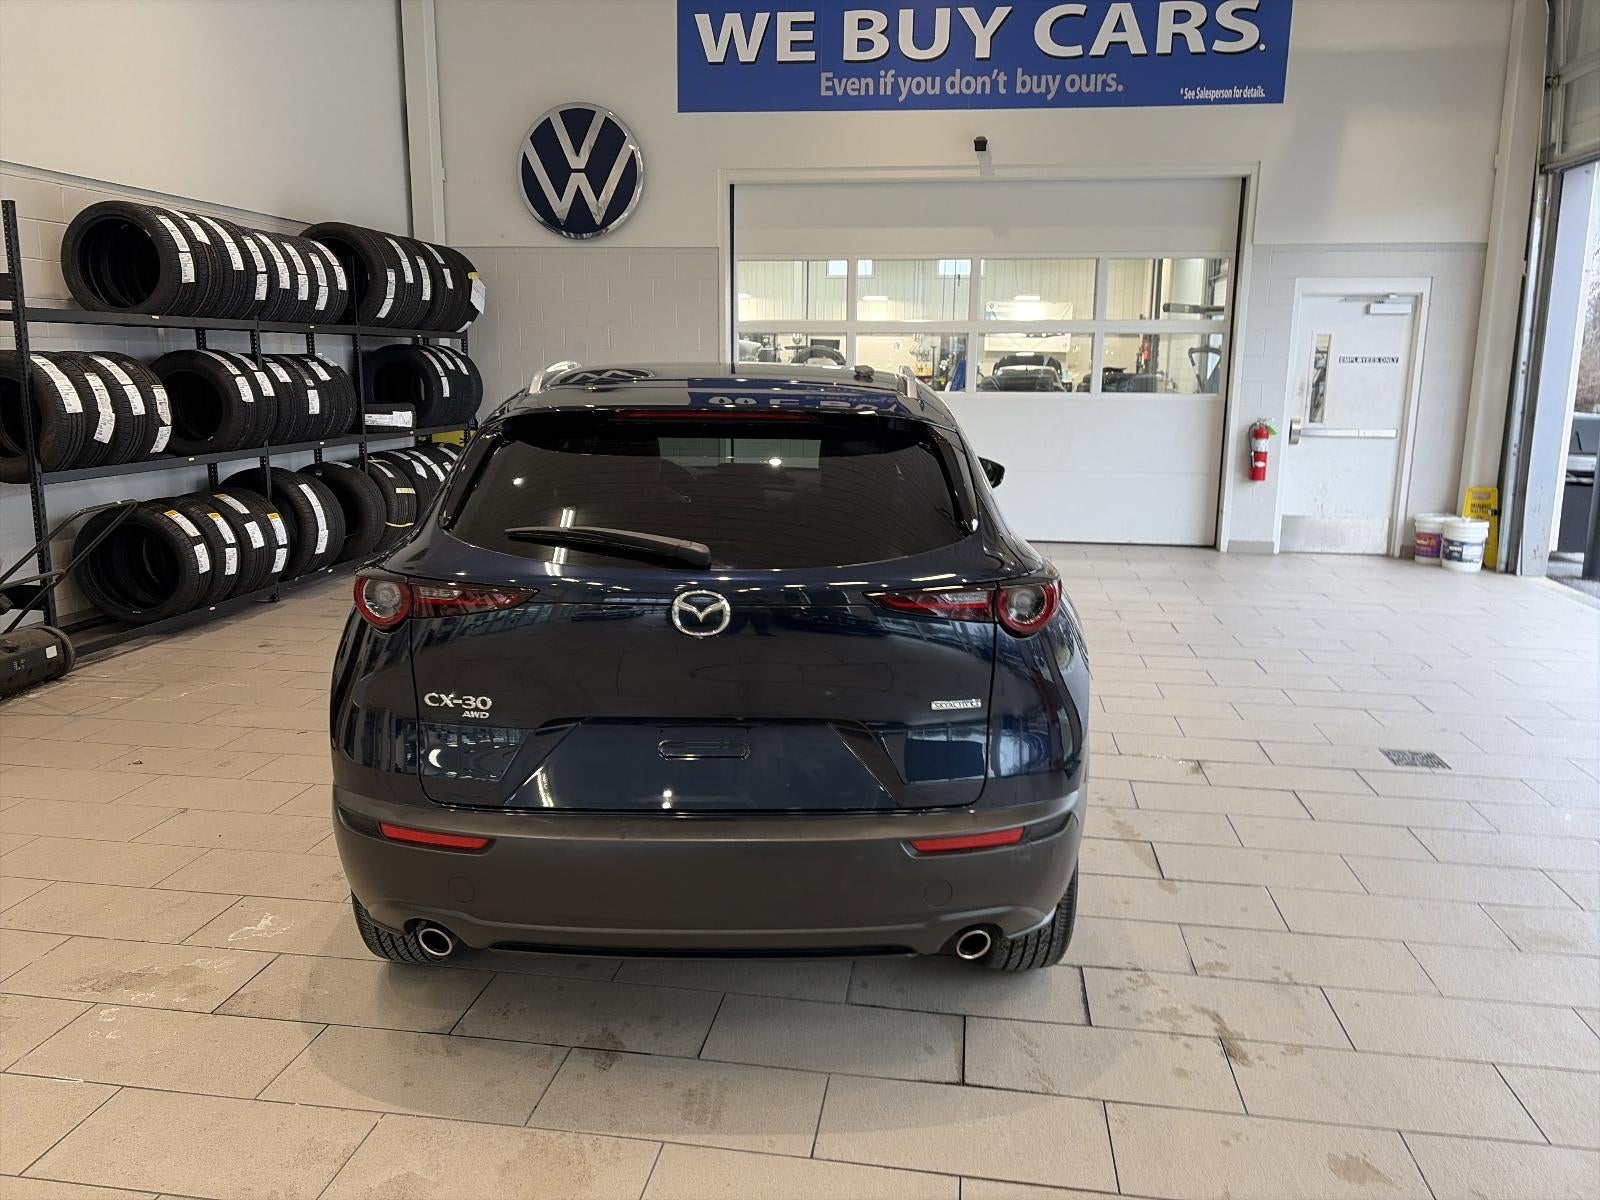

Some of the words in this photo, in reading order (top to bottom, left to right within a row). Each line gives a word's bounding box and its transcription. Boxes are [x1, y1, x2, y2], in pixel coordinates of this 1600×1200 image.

[694, 11, 816, 64] WE
[843, 6, 1012, 62] BUY
[1033, 0, 1266, 58] CARS.
[820, 71, 874, 97] Even
[878, 69, 897, 96] if
[898, 75, 941, 103] you
[944, 68, 1007, 96] don't
[1015, 67, 1061, 101] buy
[1064, 71, 1124, 94] ours.
[1195, 86, 1233, 102] Salesperson
[1233, 85, 1243, 99] for
[1242, 85, 1266, 99] details.
[423, 692, 493, 711] CX-30
[461, 710, 490, 719] AWD
